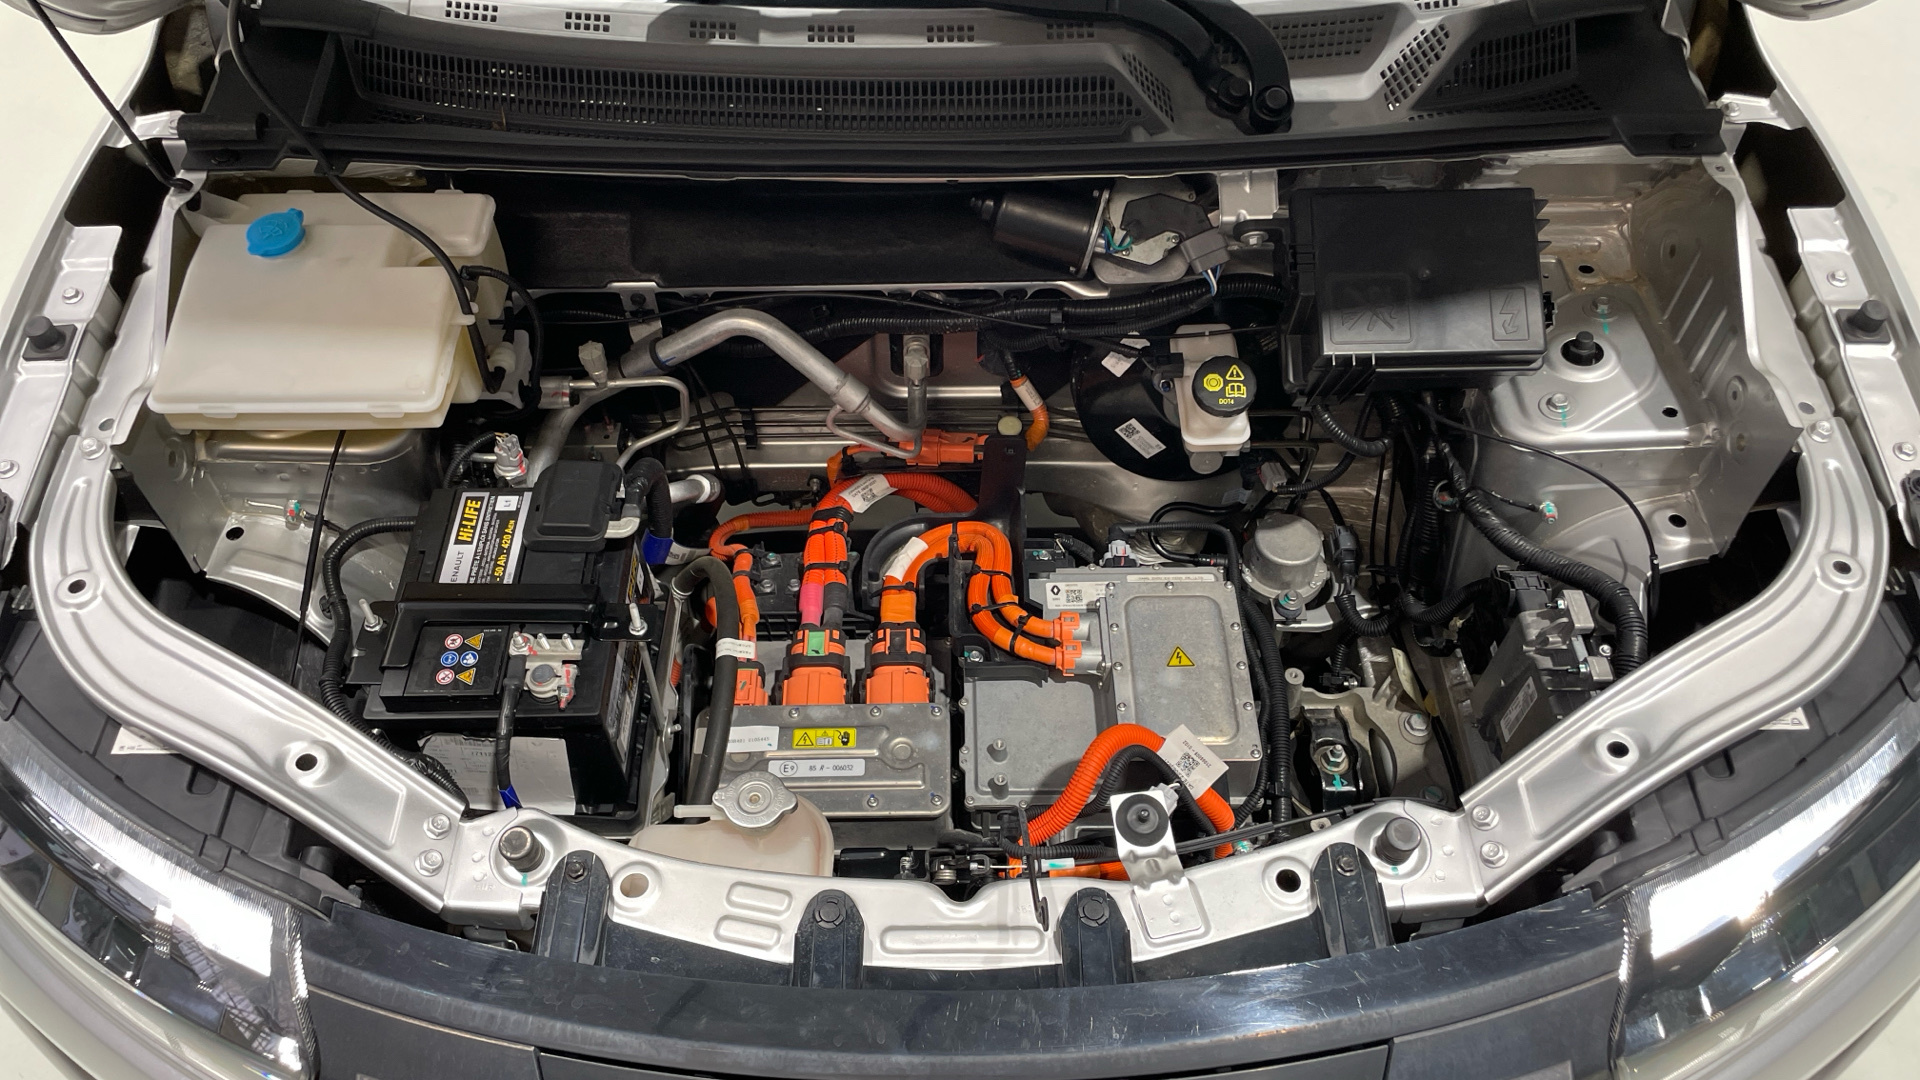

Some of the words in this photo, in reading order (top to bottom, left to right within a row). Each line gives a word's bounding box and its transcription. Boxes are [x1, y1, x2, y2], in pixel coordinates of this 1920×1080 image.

[501, 534, 512, 549] 420
[450, 551, 464, 582] ENAULT
[497, 554, 507, 566] Ah
[494, 566, 504, 577] 50
